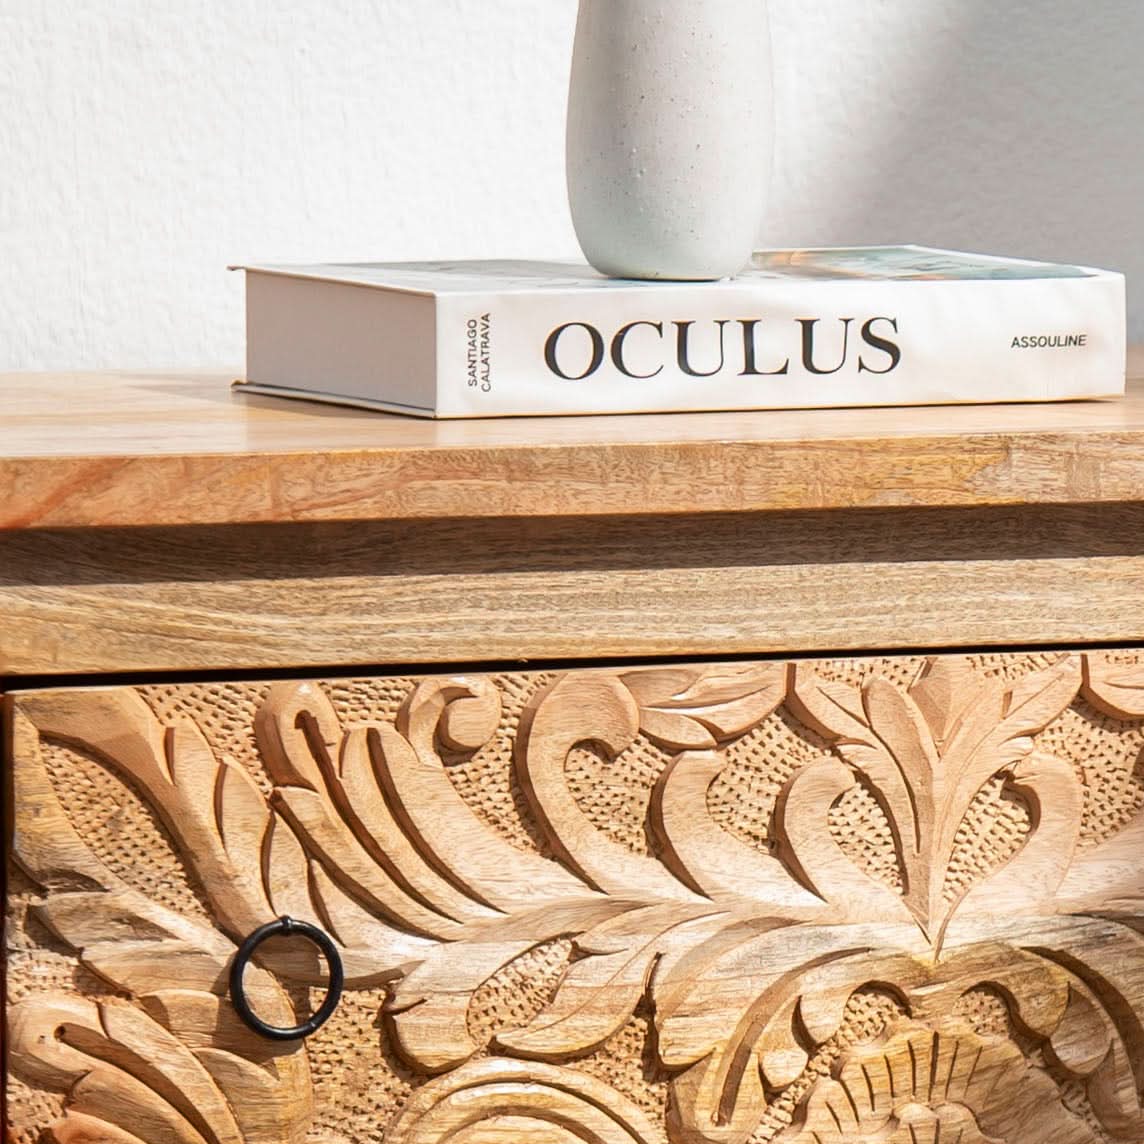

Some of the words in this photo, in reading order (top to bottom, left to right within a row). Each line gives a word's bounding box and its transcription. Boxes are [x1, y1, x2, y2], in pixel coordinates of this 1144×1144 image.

[467, 318, 478, 387] SANTIAGO
[480, 312, 491, 393] CALATRAVA
[544, 317, 902, 381] OCULUS
[1010, 334, 1087, 349] ASSOULINE
